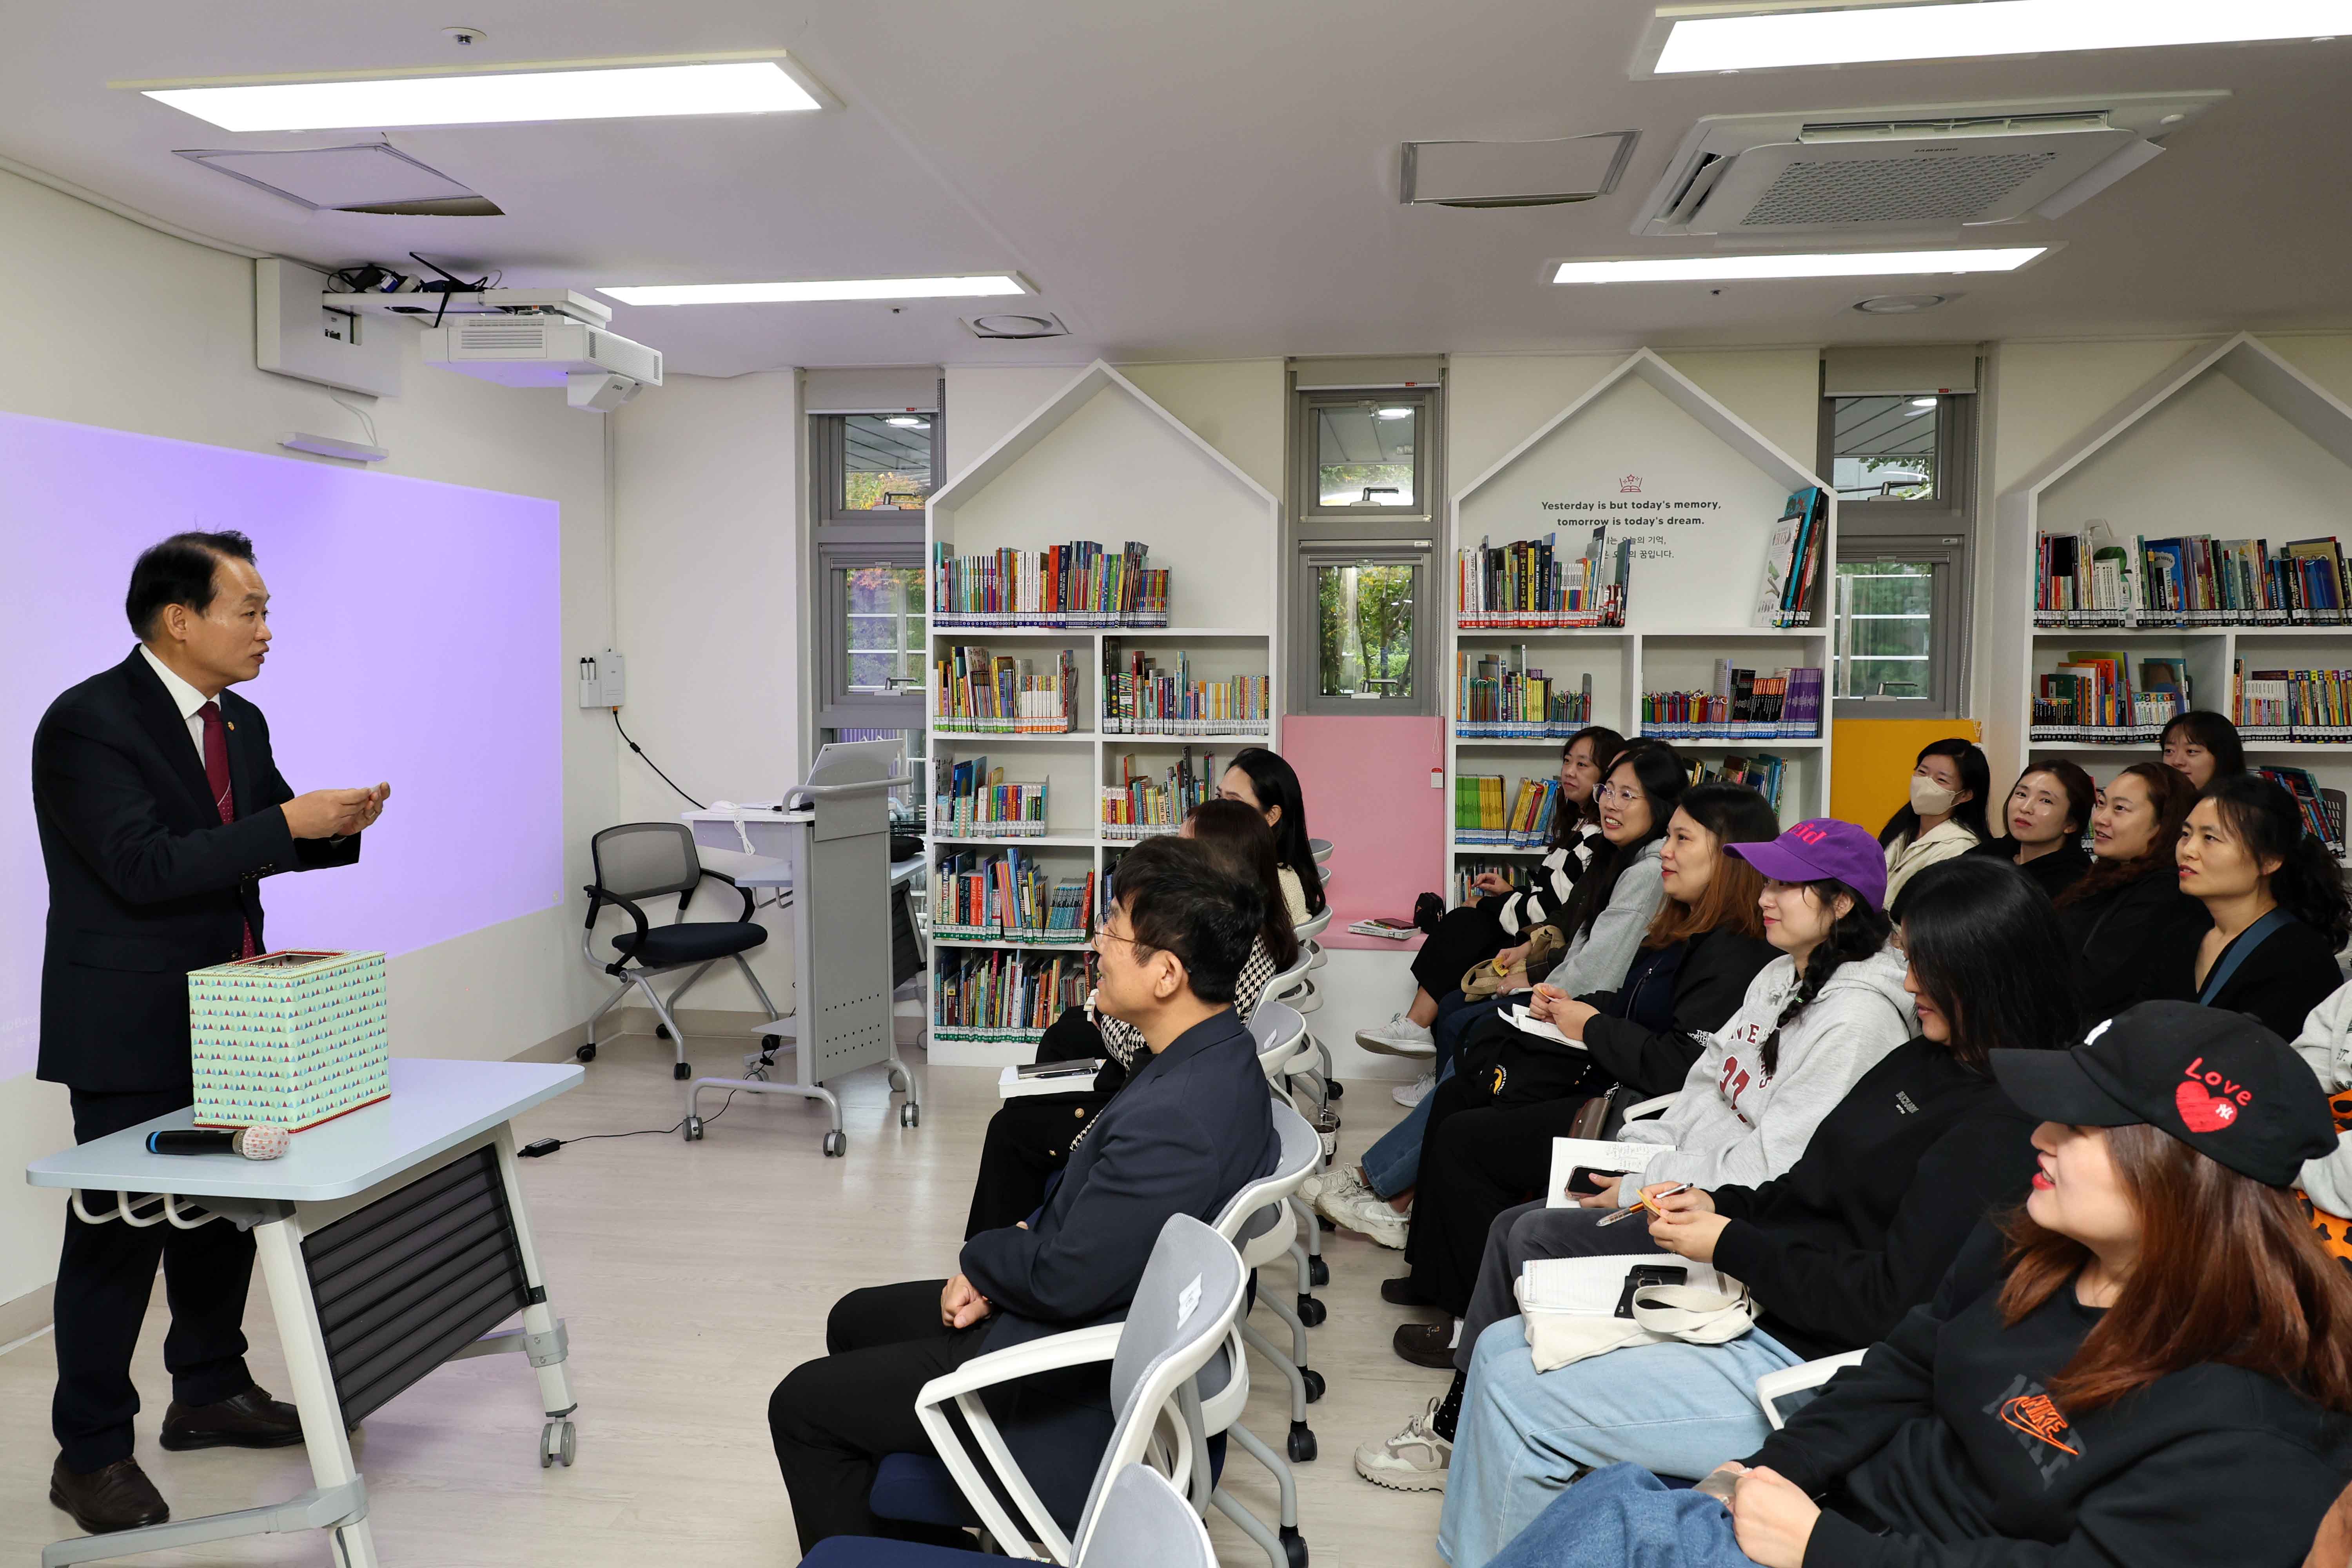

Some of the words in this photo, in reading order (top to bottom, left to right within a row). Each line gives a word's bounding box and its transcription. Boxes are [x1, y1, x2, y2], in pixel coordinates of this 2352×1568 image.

[1541, 501, 1595, 512] Yesterday
[1597, 501, 1606, 510] is
[1610, 501, 1628, 510] but
[1631, 500, 1671, 511] today's
[1674, 501, 1721, 510] memory,
[1557, 518, 1609, 526] tomorrow
[1612, 517, 1621, 526] is
[1624, 516, 1664, 527] today's
[1667, 516, 1704, 525] dream.
[1648, 536, 1666, 545] 기억,
[1640, 550, 1674, 559] 꿈입니다.
[2185, 1057, 2252, 1105] Love
[2021, 1394, 2069, 1435] NIKE
